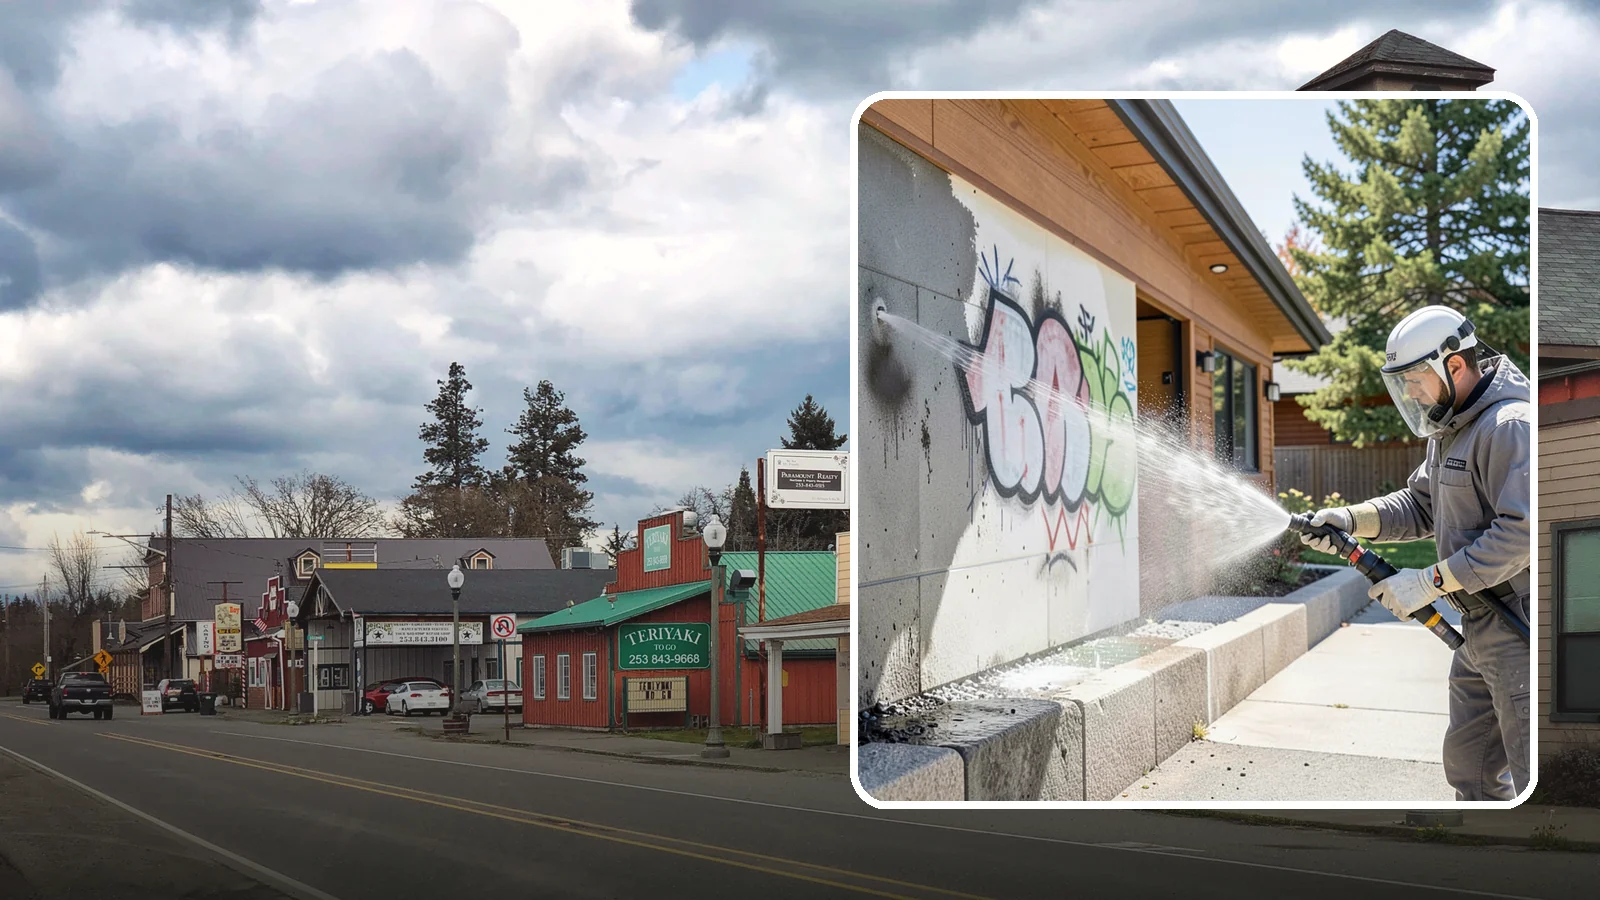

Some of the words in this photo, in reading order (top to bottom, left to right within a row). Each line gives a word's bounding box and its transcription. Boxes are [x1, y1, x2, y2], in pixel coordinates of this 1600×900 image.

[625, 627, 702, 646] TERIYAKI
[628, 654, 648, 665] 253
[651, 653, 700, 664] 843-9668
